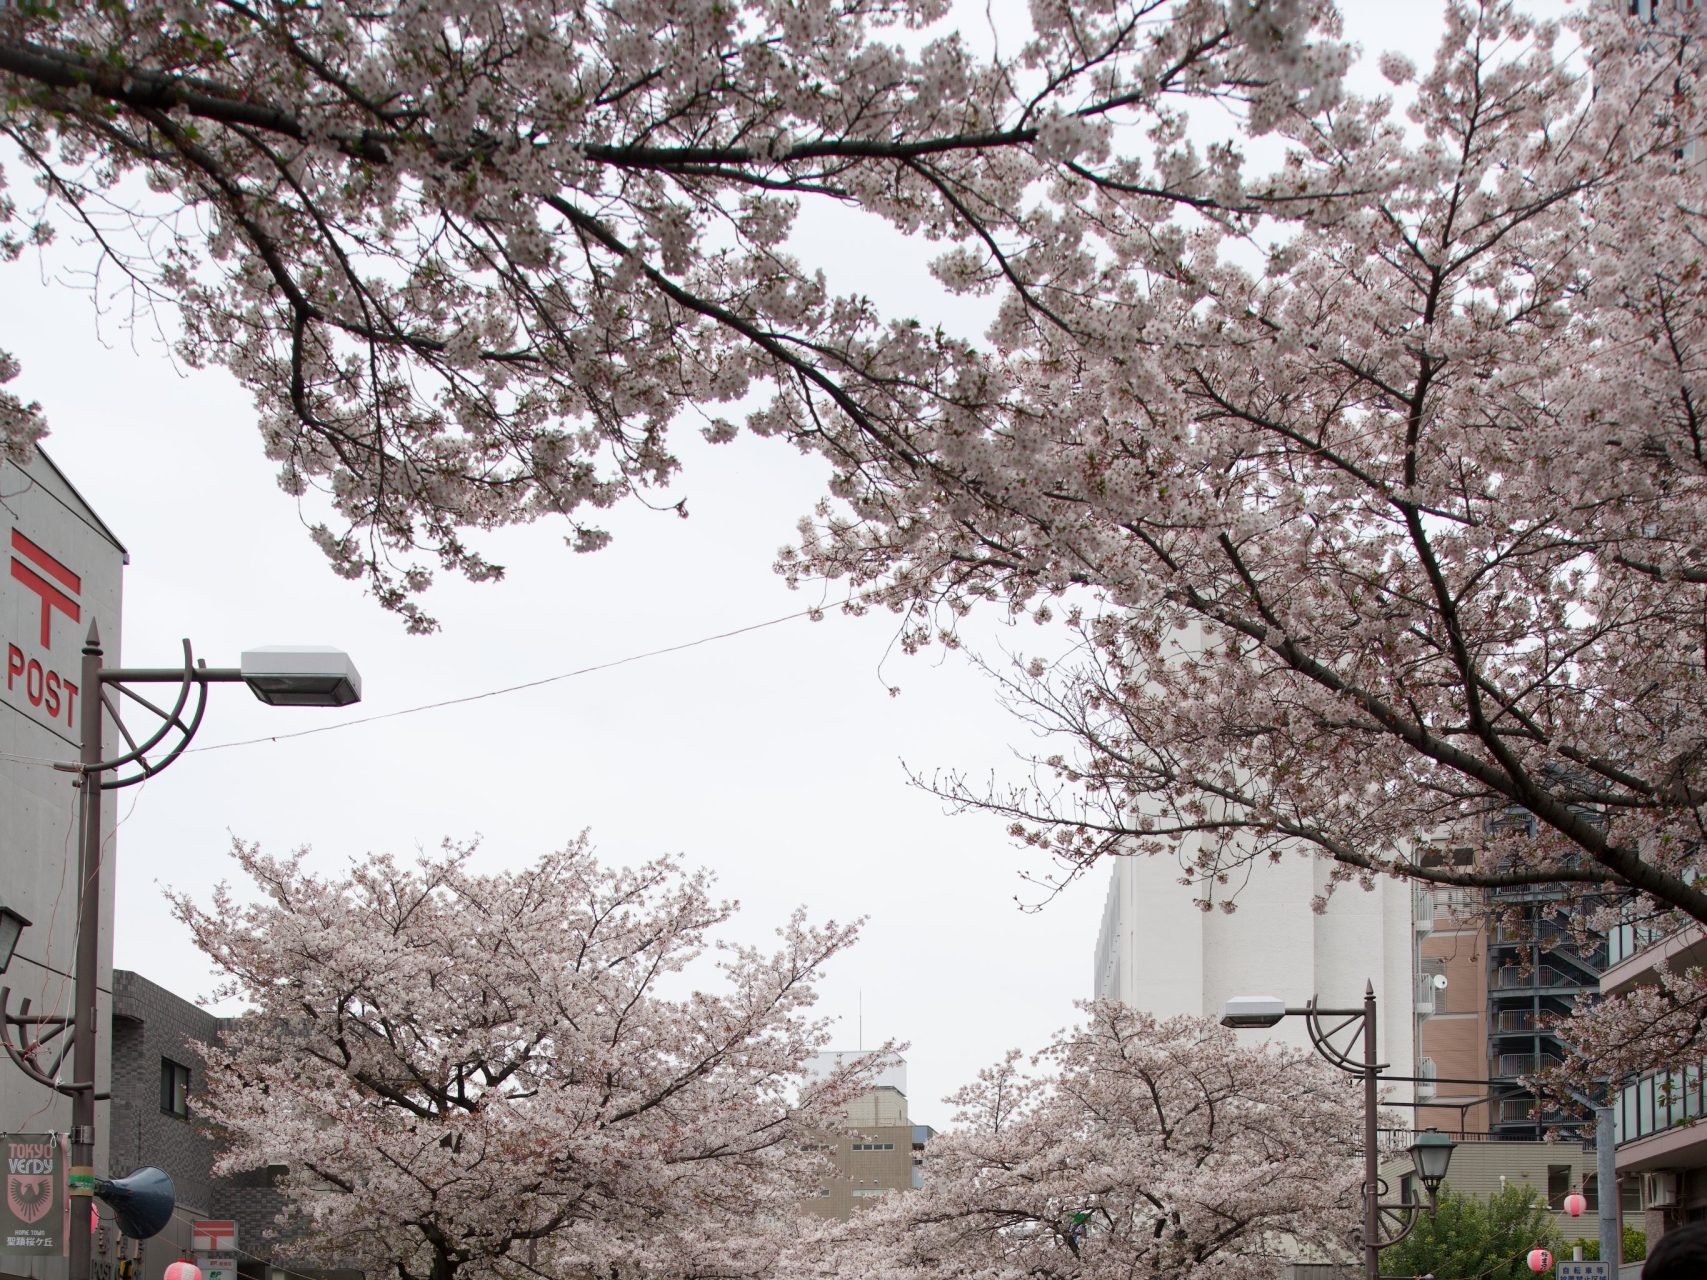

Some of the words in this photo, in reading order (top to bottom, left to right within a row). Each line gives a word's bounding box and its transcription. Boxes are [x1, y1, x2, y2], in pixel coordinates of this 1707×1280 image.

[8, 642, 79, 728] POST
[7, 1143, 54, 1159] TOKYO
[1562, 1266, 1604, 1275] 自転車等
